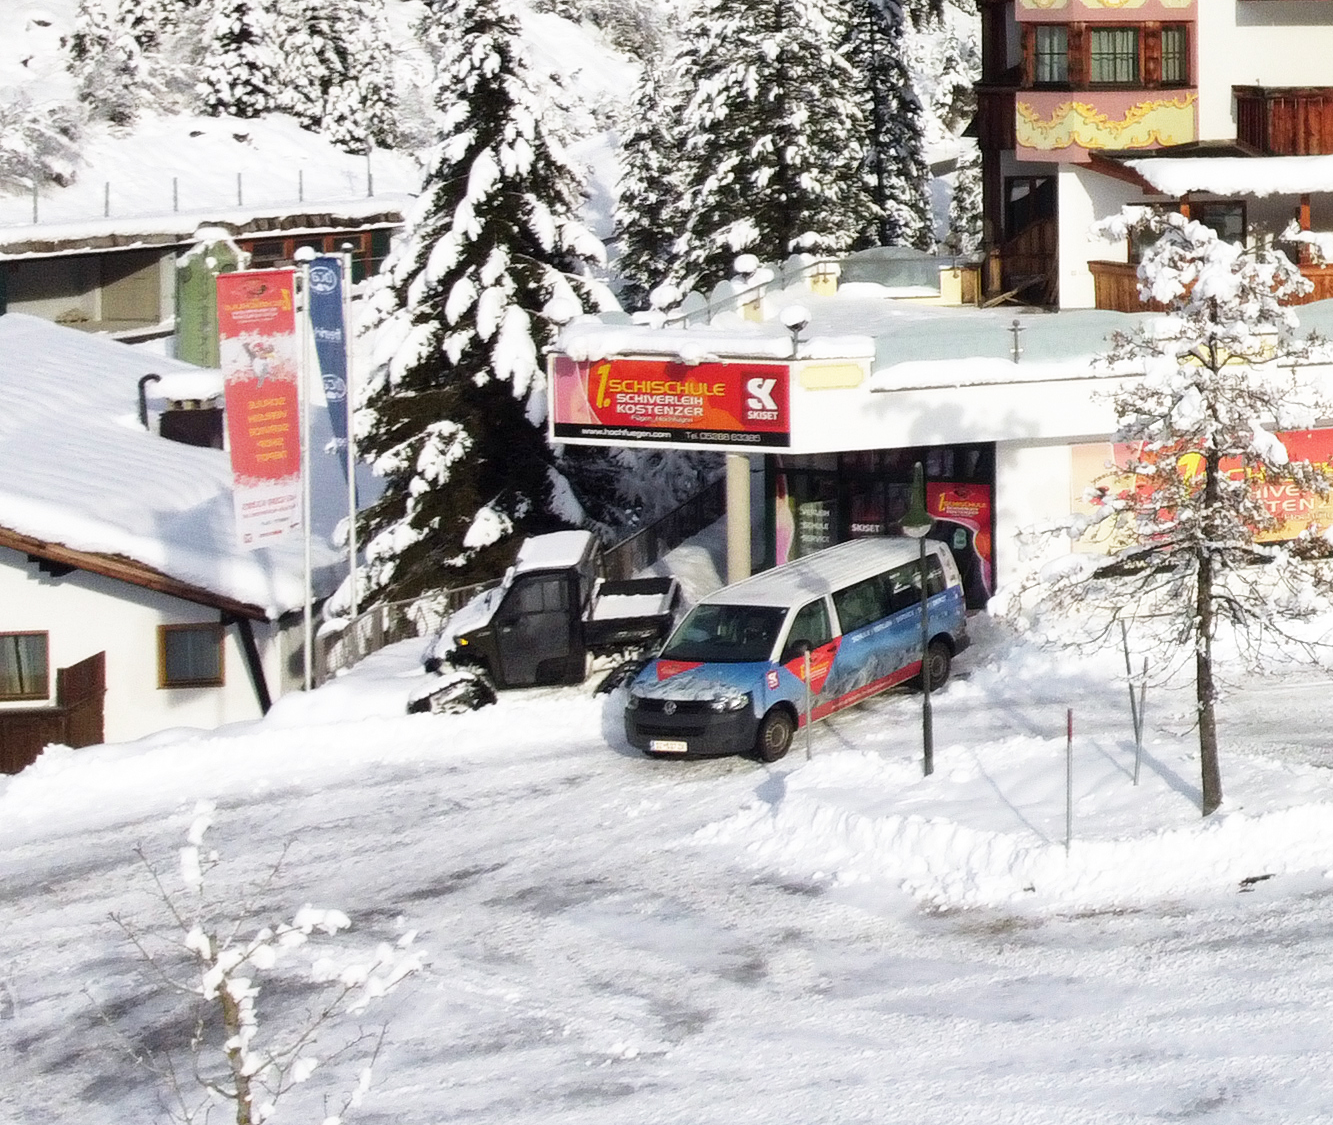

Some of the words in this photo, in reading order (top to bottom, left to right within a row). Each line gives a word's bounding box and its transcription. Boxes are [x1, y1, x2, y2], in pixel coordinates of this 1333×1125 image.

[609, 379, 726, 397] SCHISCHULE
[616, 393, 704, 406] SCHIVERLEIH
[616, 405, 704, 417] KOSTENZER
[747, 411, 778, 421] SKISET
[851, 523, 880, 533] SKISET
